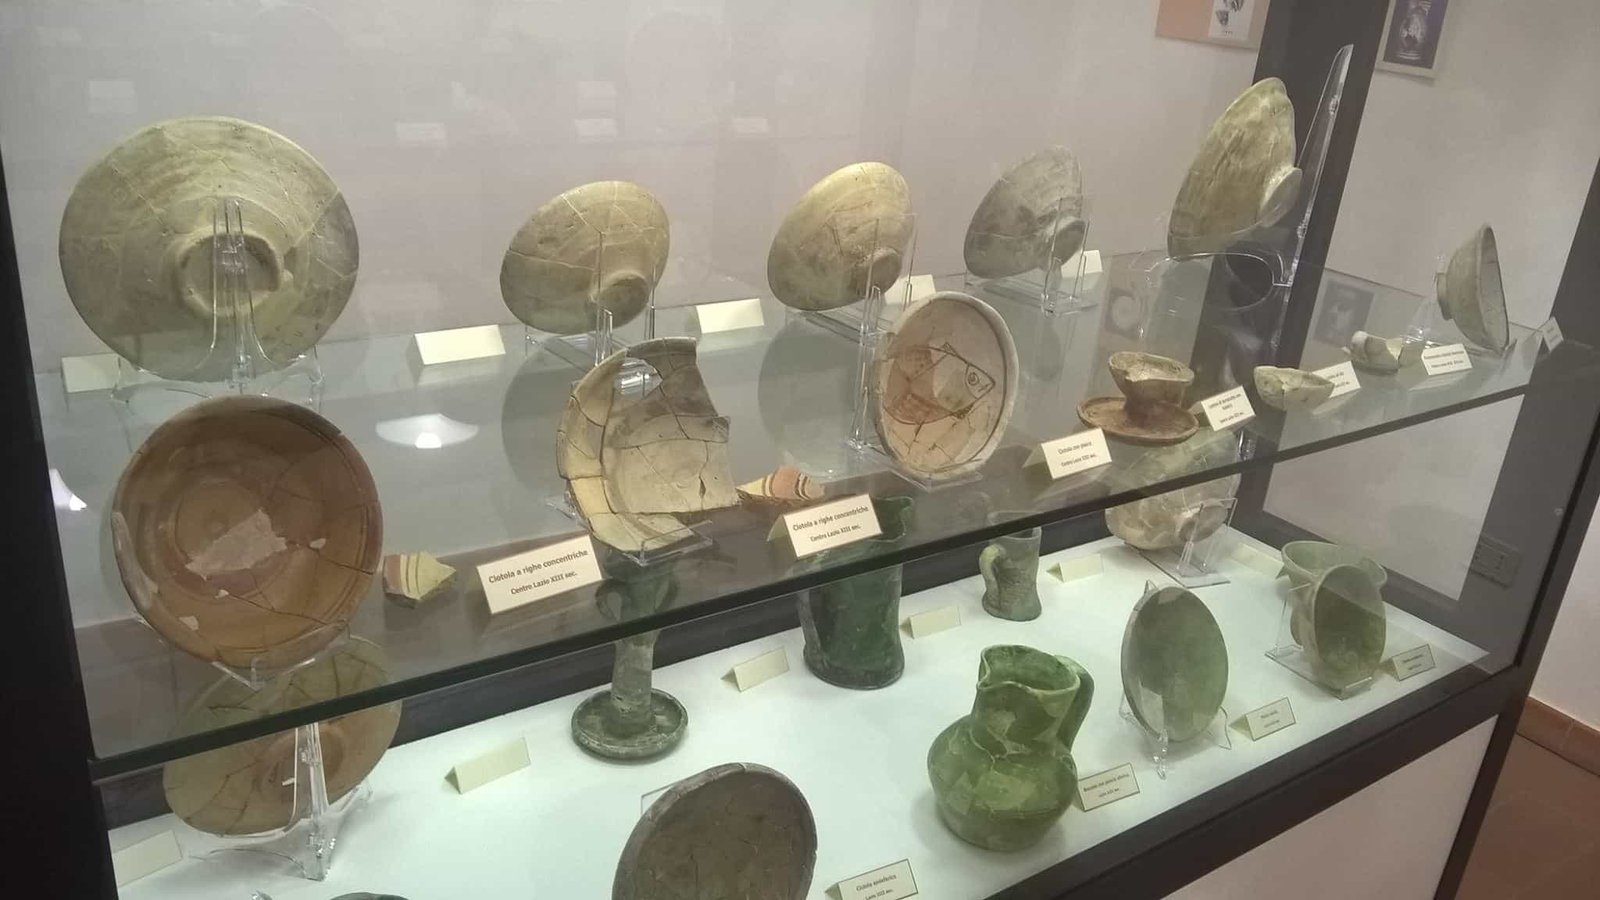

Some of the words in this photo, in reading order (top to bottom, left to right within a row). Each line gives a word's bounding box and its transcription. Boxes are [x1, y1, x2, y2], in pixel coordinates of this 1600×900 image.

[793, 521, 813, 531] Ciotola
[819, 515, 833, 525] righe
[834, 505, 869, 520] concentriche
[810, 533, 827, 542] Centro
[827, 529, 840, 537] Lazio
[840, 525, 851, 533] XIII
[489, 570, 515, 584] Ciotola
[523, 562, 542, 574] righe
[543, 549, 588, 568] concentriche
[511, 584, 533, 595] Centro
[533, 579, 550, 588] Lazio
[550, 573, 564, 583] XIII
